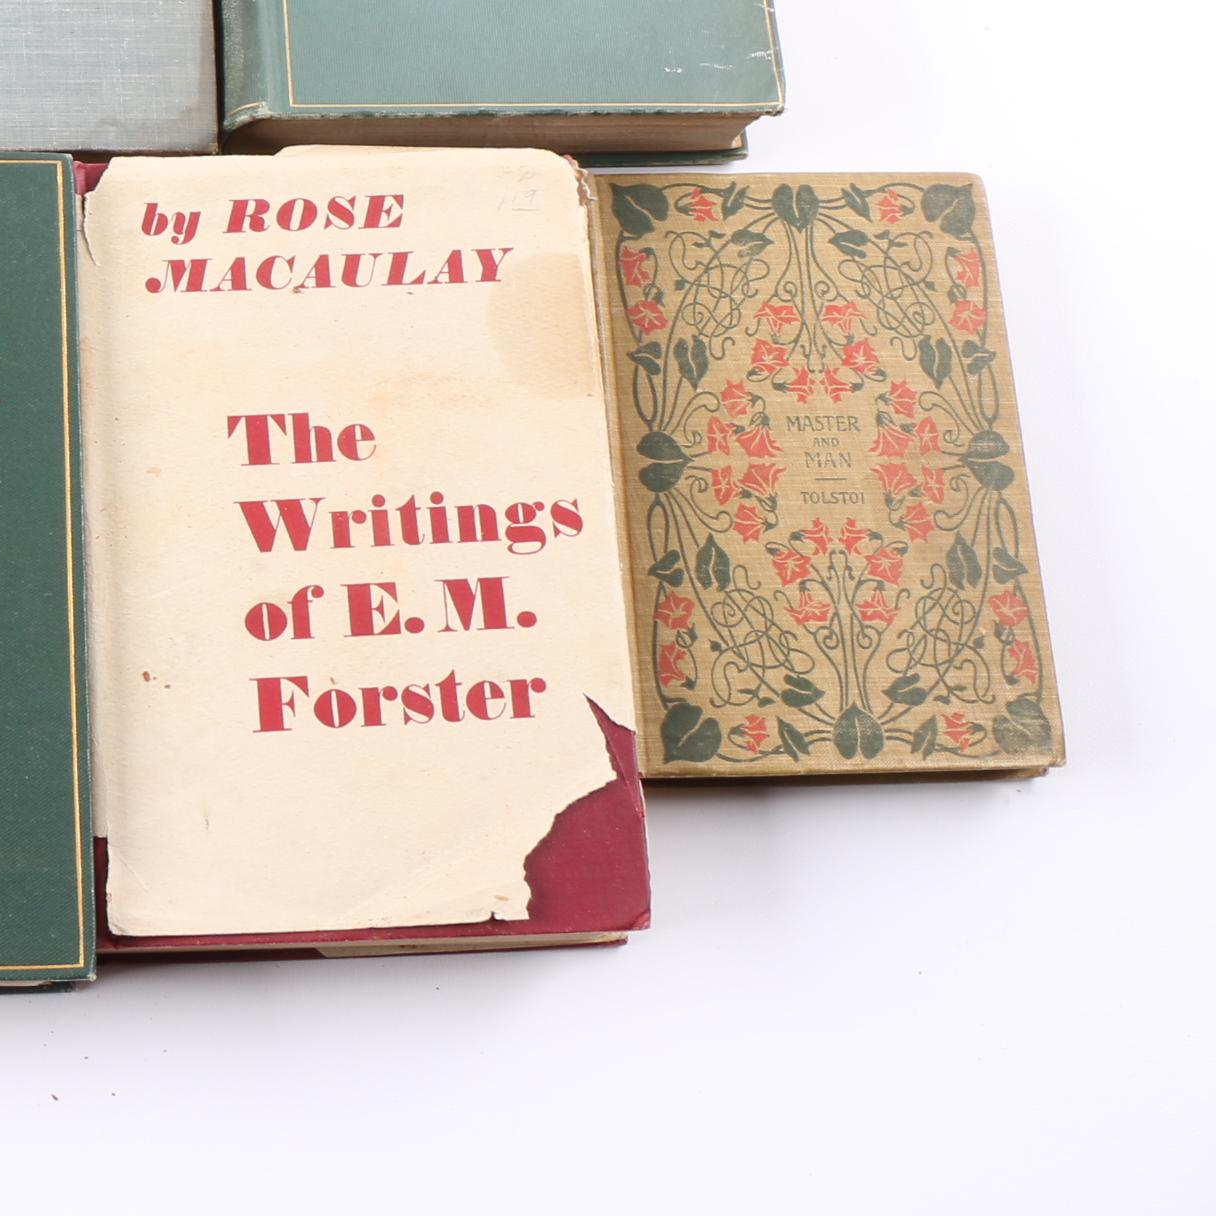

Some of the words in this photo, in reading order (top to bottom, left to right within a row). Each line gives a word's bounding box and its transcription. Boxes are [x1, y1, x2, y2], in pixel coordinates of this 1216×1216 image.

[141, 201, 201, 245] by
[223, 193, 406, 234] ROSE
[144, 246, 514, 294] MACAULAY
[226, 411, 377, 466] The
[786, 415, 860, 432] MASTER
[813, 437, 839, 447] AND
[804, 451, 852, 468] MAN
[233, 490, 584, 556] Writings
[800, 491, 865, 505] TOLSTOI
[244, 584, 325, 642] of
[250, 669, 548, 733] Forster
